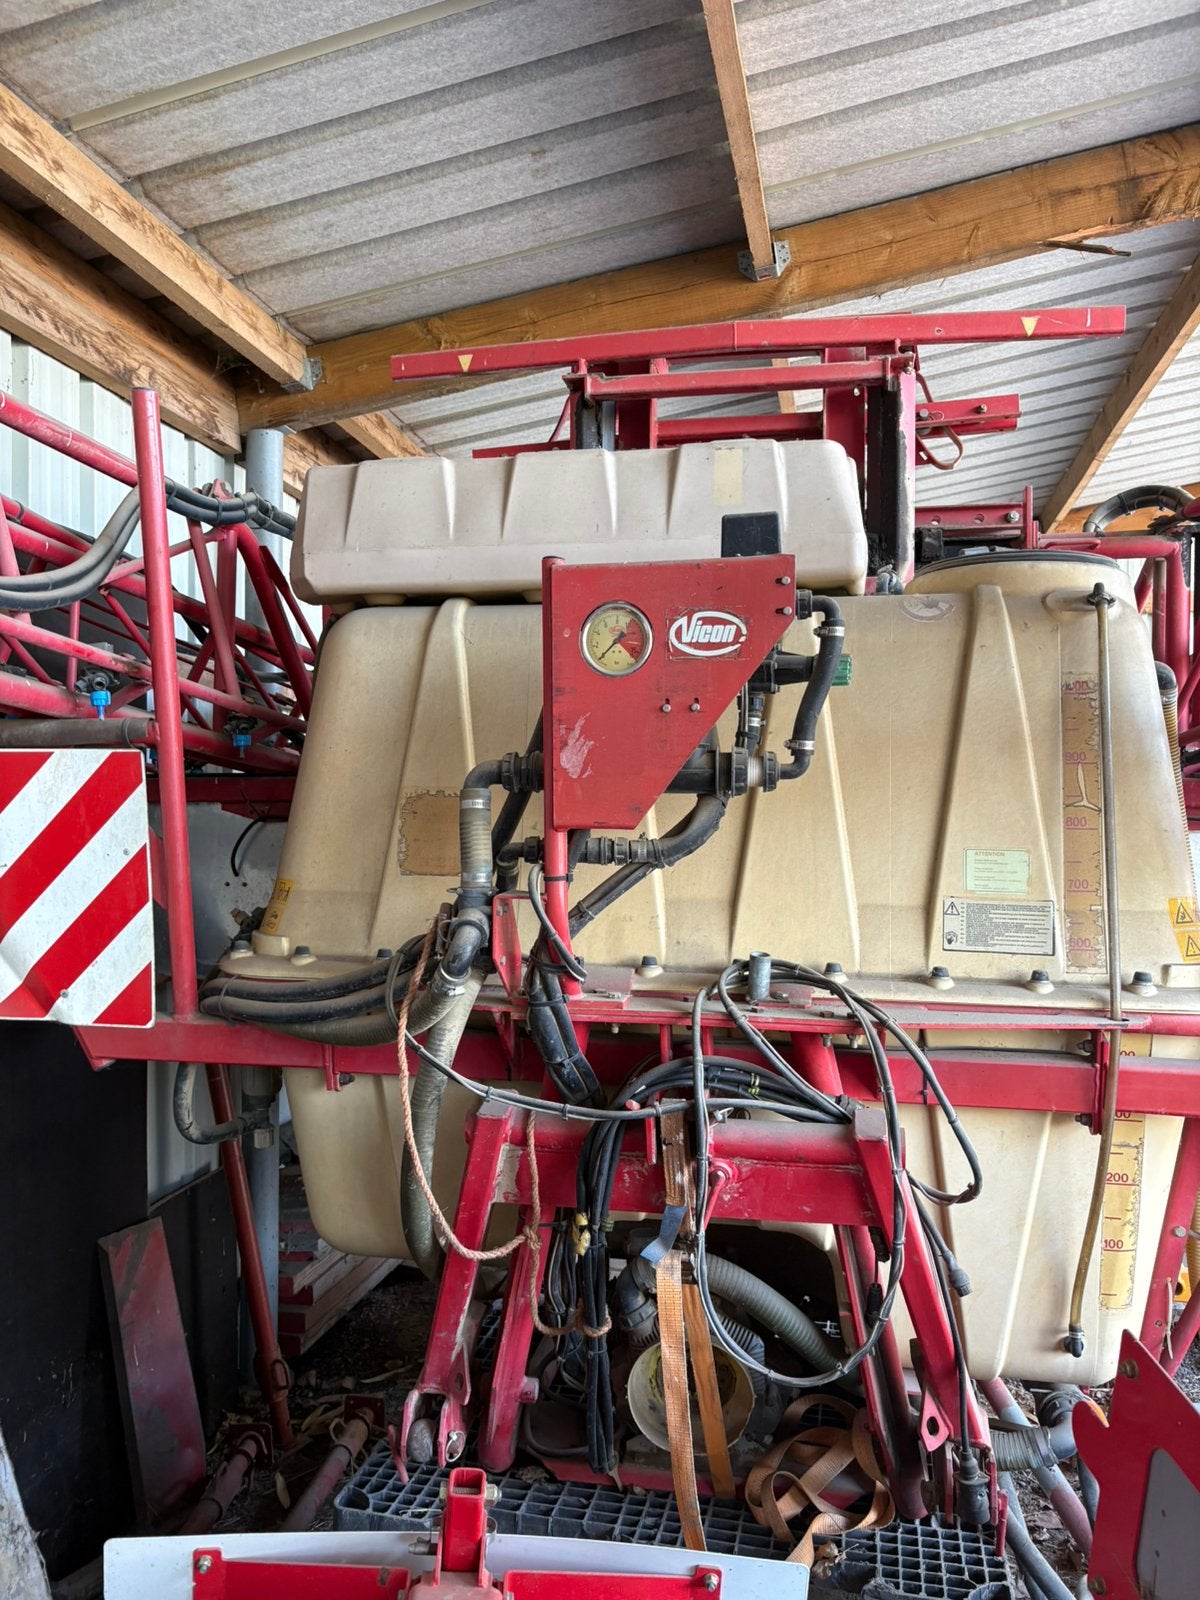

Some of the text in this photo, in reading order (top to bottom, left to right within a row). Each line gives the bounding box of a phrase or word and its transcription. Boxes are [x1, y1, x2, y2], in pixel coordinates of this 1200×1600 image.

[679, 612, 738, 644] Vicon
[1064, 751, 1087, 762] 900
[1065, 816, 1087, 827] 800
[1067, 879, 1089, 890] 700
[1106, 1172, 1129, 1183] 200
[1103, 1238, 1124, 1250] 100
